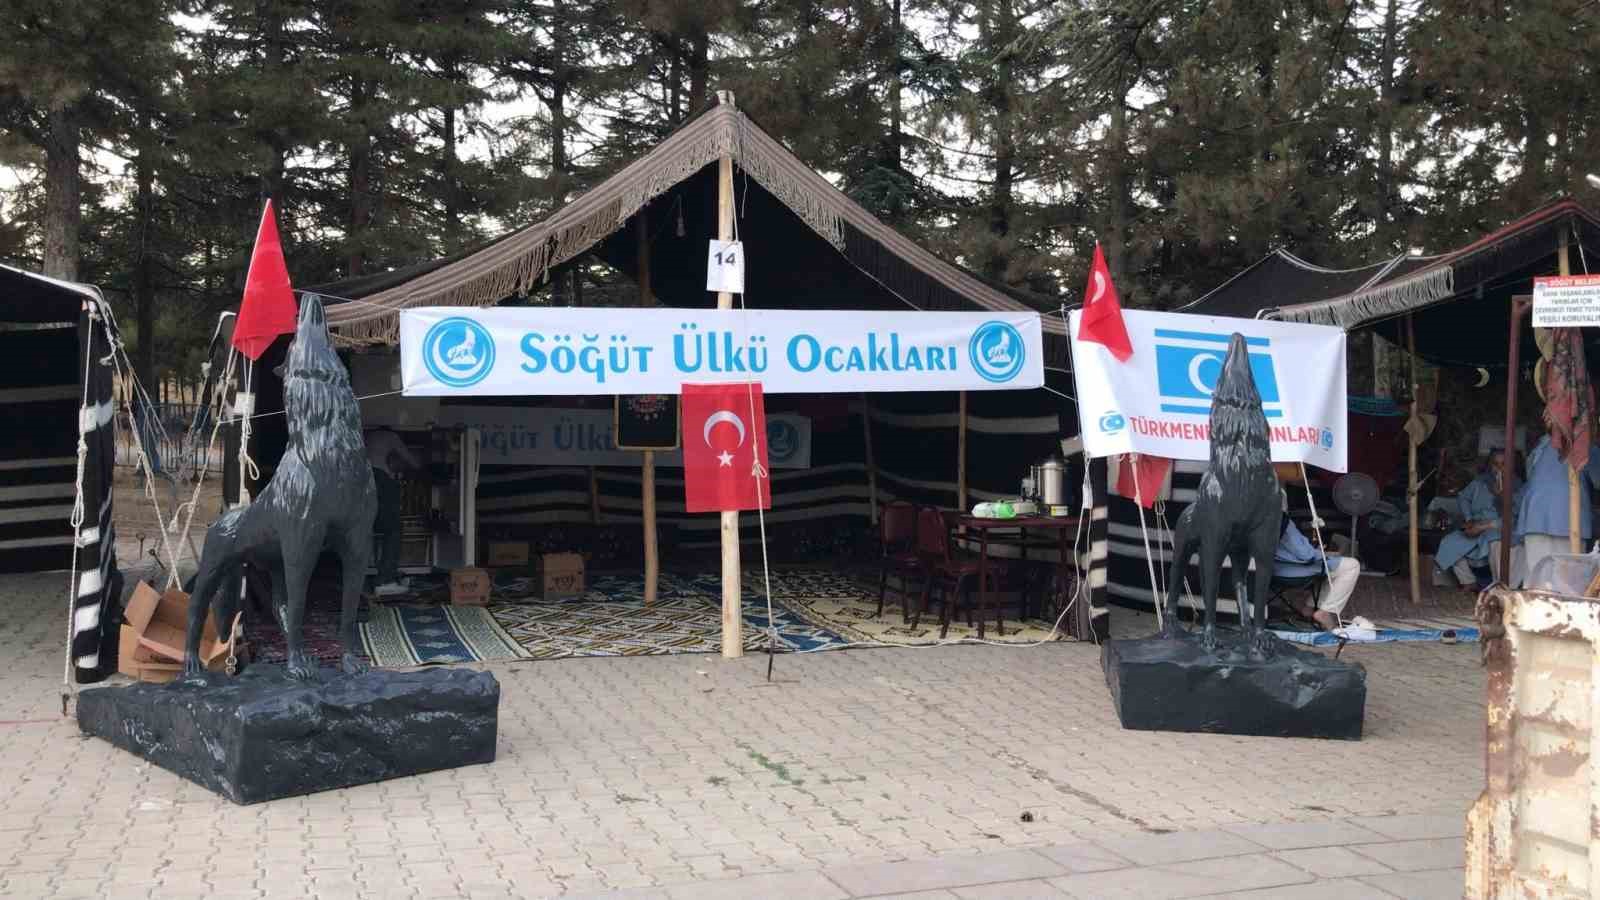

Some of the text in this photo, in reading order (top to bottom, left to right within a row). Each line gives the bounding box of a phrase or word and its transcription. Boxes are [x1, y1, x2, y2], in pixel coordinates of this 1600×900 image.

[714, 251, 736, 266] 14
[673, 322, 768, 375] Ülkü
[551, 415, 614, 453] Ülk
[1129, 415, 1212, 441] TÜRKMEN
